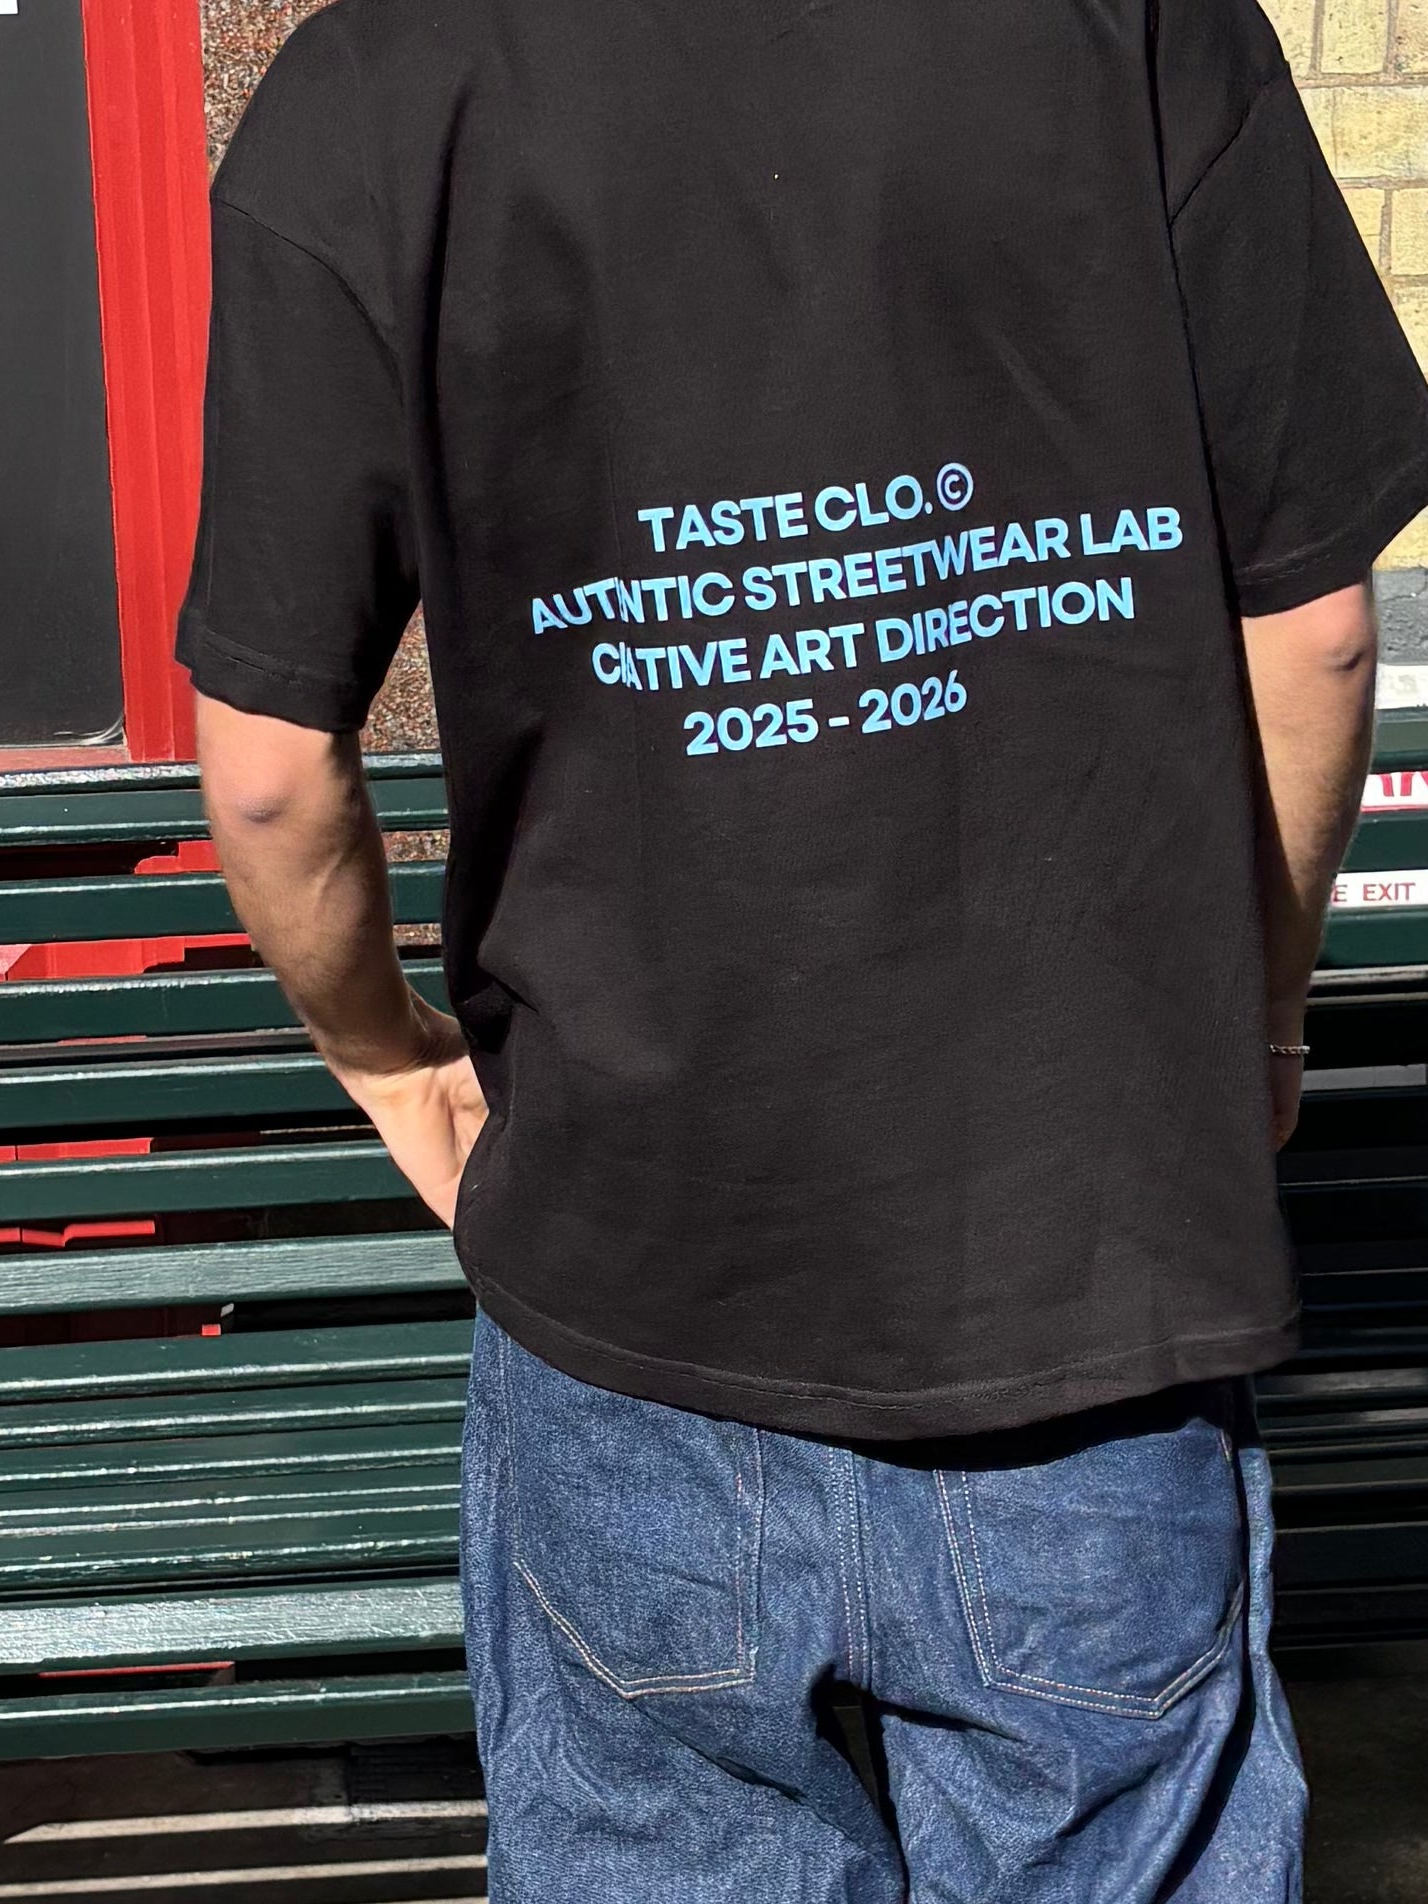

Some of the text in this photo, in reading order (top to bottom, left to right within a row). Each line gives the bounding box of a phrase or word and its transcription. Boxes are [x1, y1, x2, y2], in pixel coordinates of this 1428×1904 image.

[638, 492, 804, 552] TASTE
[743, 518, 1072, 611] STREETWEAR
[1080, 507, 1183, 555] LAB
[760, 623, 865, 679] ART
[876, 577, 1134, 662] DIRECTION
[684, 699, 819, 756] 2025
[859, 669, 967, 734] 2026
[1363, 882, 1416, 902] EXIT
